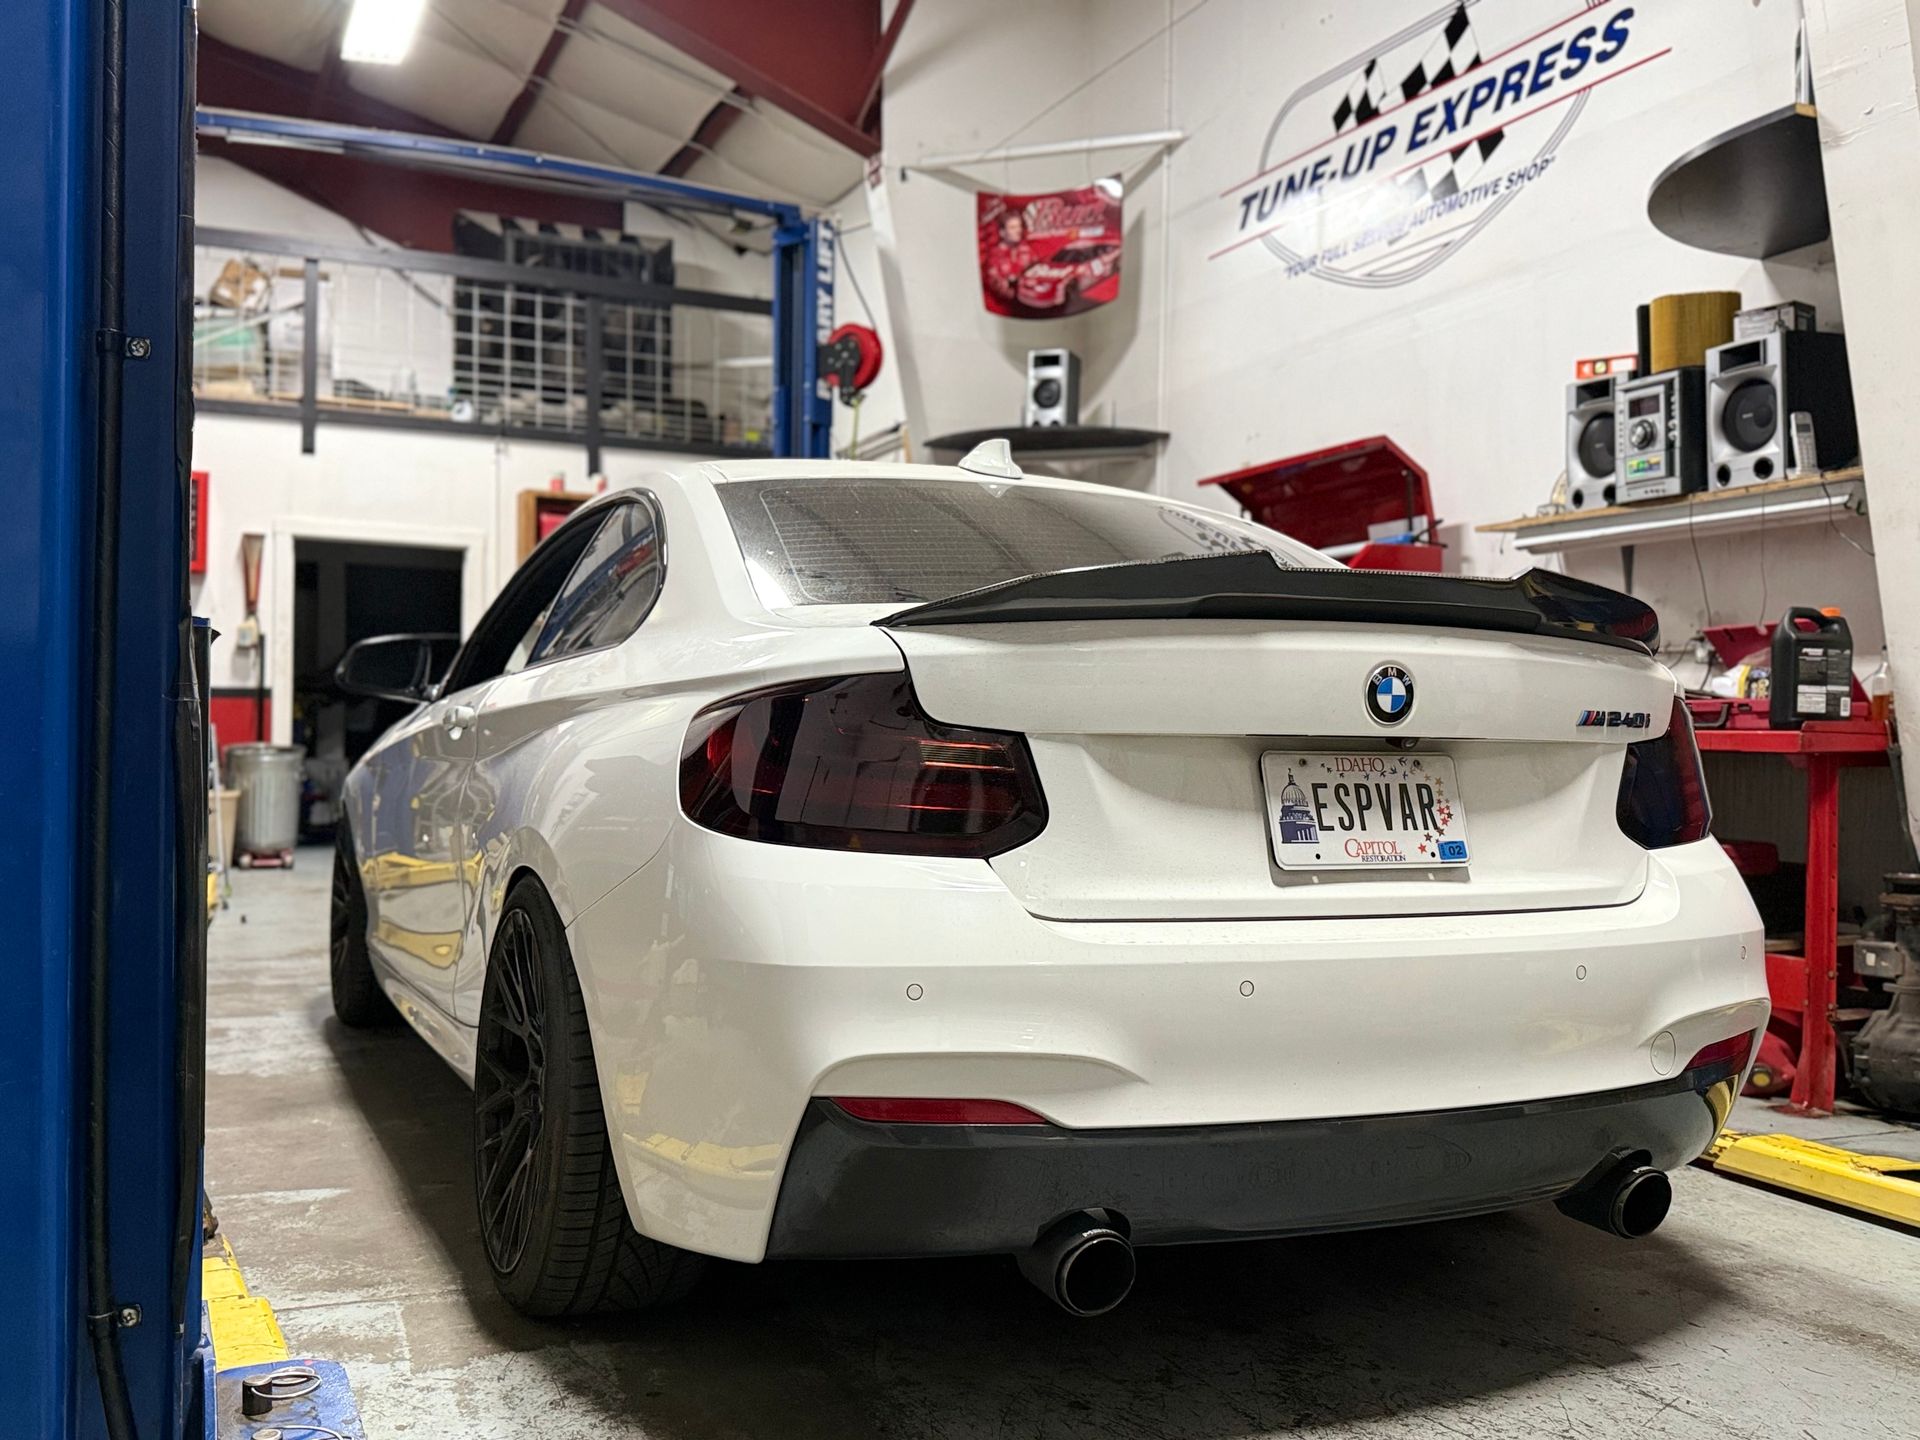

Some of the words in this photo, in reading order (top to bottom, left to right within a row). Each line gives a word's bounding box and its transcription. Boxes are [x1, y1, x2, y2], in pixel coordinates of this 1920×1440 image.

[1239, 125, 1398, 231] TUNE-UP
[1406, 7, 1635, 154] EXPRESS
[1410, 177, 1503, 227] AUTOMOTIVE
[816, 223, 833, 284] LIFT
[816, 288, 833, 400] RARY
[1372, 667, 1411, 687] BMW
[1334, 757, 1385, 773] IDAHO
[1311, 782, 1439, 832] ESPVAR
[1361, 854, 1406, 863] RESTORATION
[1448, 845, 1463, 856] 02
